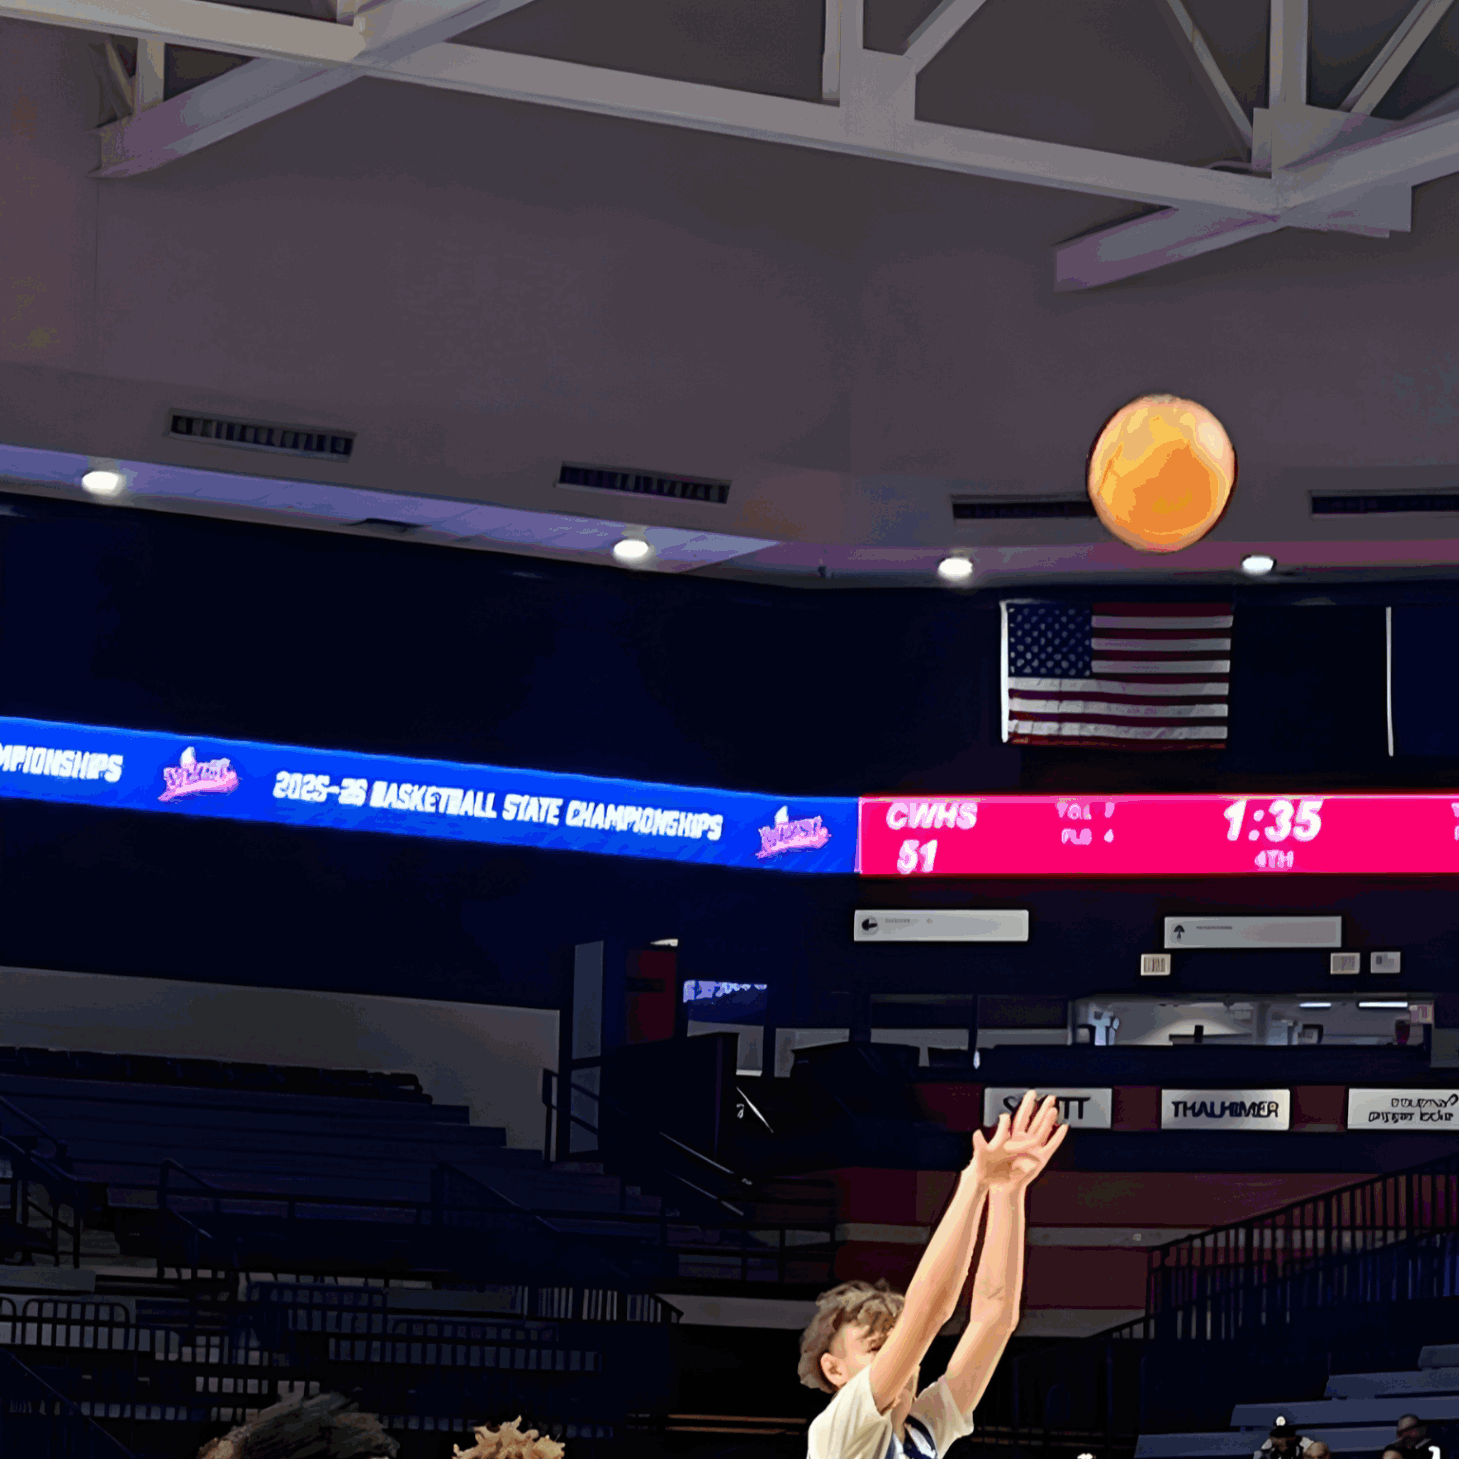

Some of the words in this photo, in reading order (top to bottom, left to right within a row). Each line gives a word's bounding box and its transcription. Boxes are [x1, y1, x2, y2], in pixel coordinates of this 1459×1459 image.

[369, 781, 497, 819] BASKETBALL
[502, 794, 563, 826] STATE
[886, 801, 978, 830] CWHS
[1223, 799, 1324, 842] 1:35
[897, 839, 938, 875] 51
